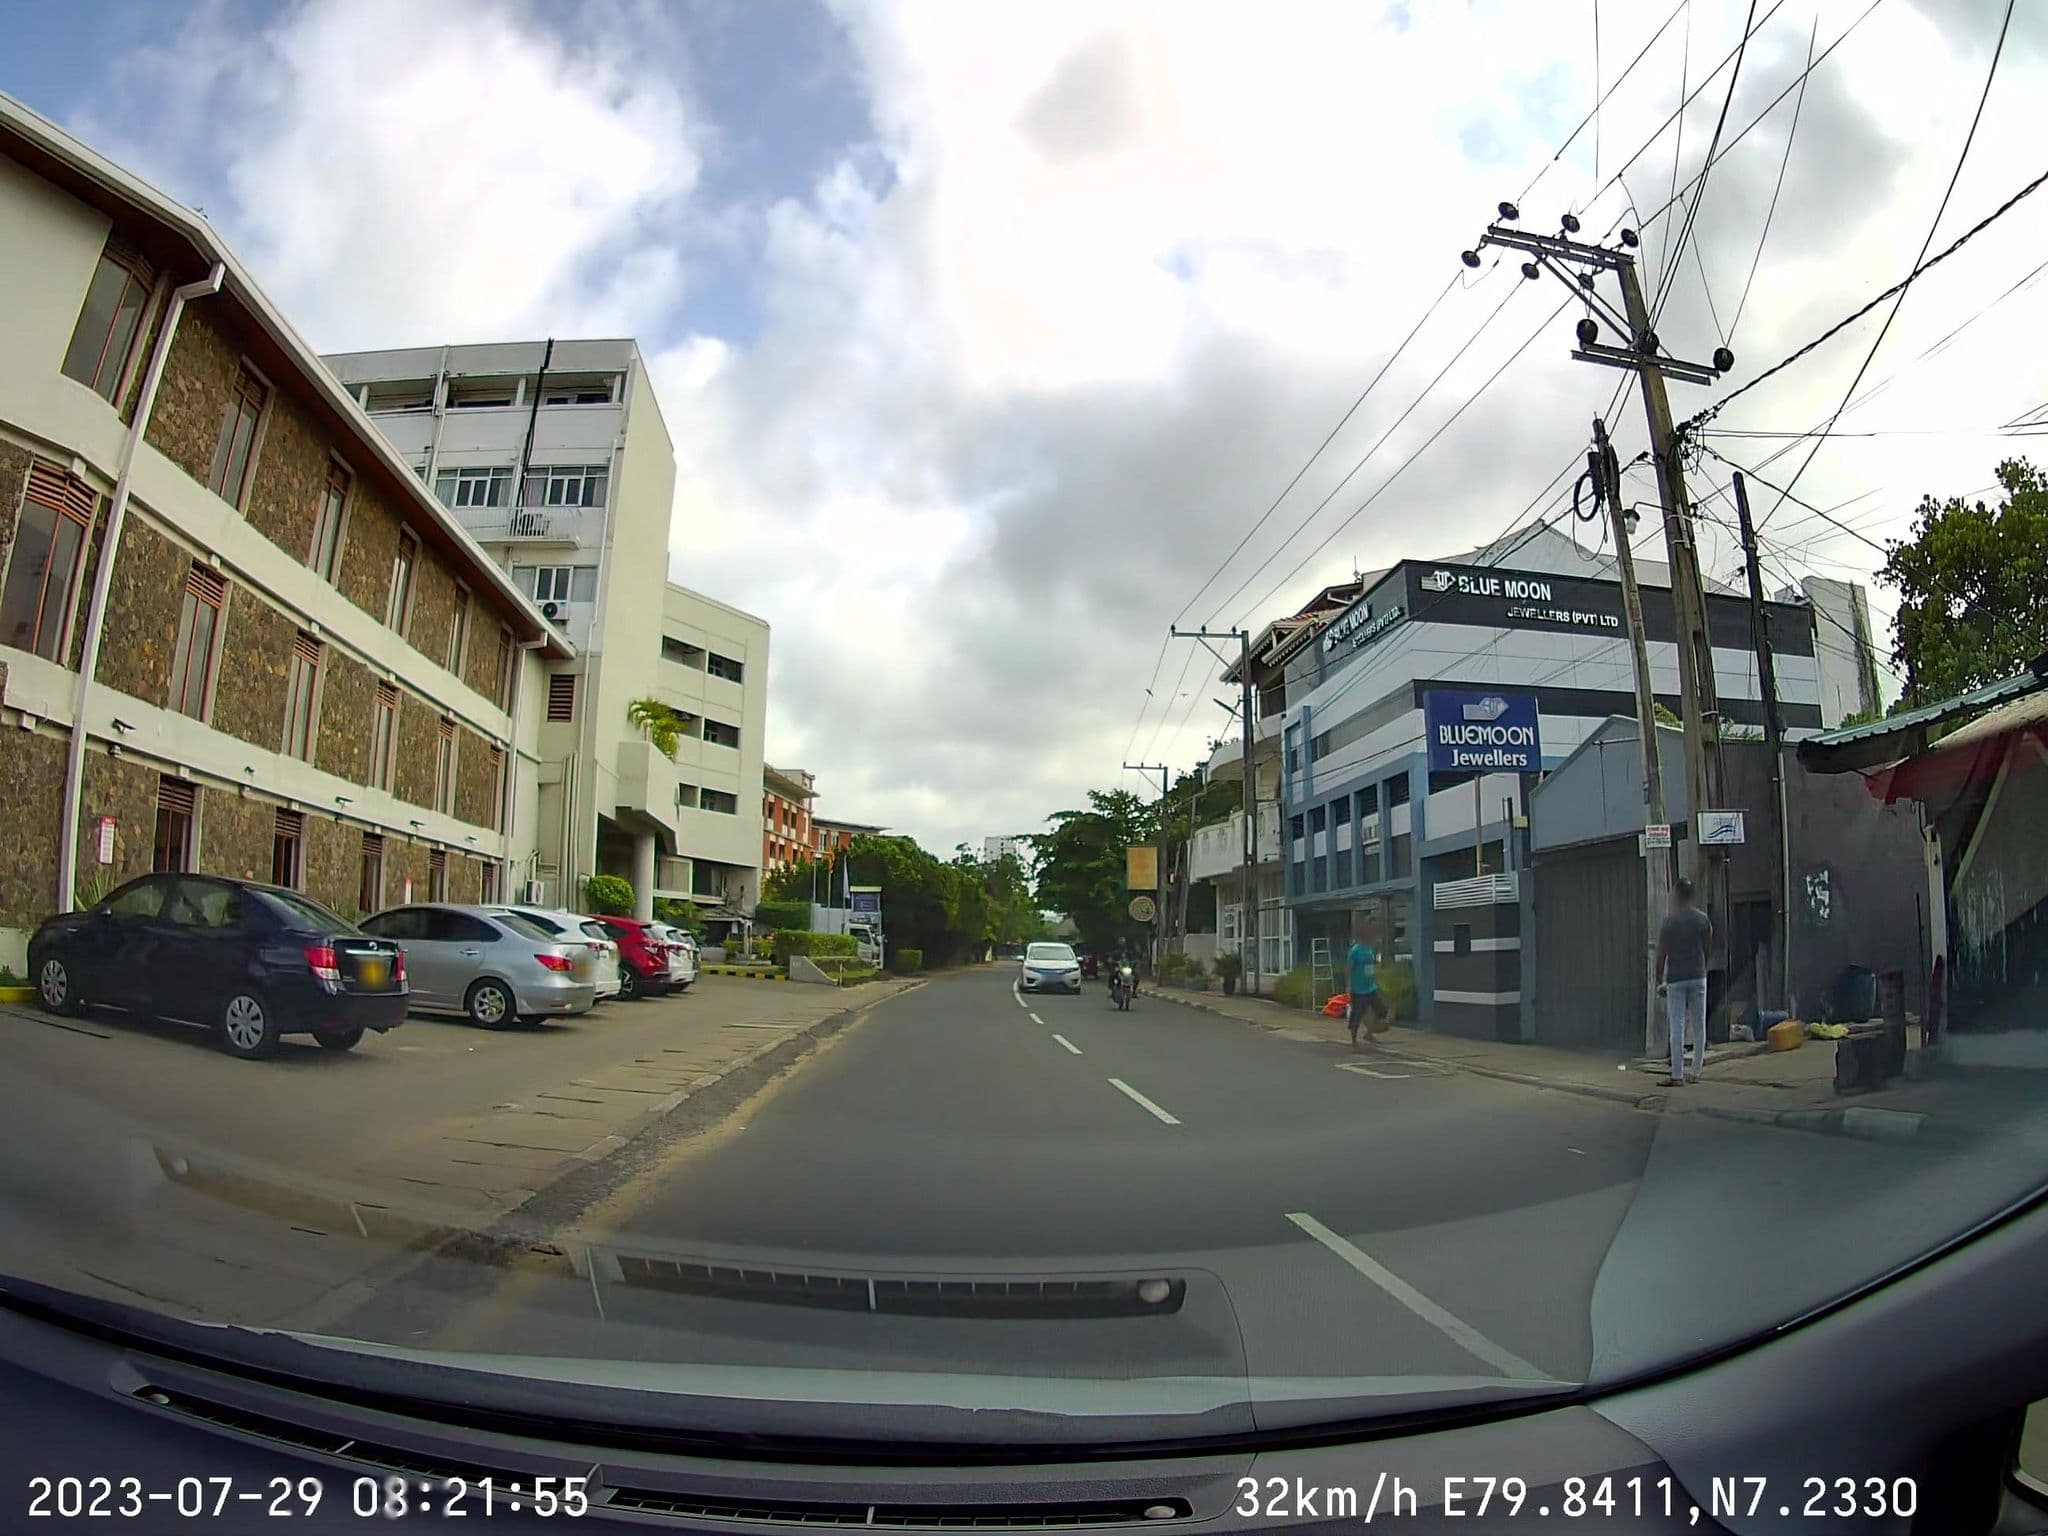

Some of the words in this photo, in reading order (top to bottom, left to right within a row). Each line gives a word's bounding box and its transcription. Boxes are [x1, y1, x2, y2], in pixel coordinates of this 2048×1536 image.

[1458, 575, 1502, 596] BLUE
[1504, 580, 1552, 601] MOON
[1507, 606, 1571, 623] JEWELLERS
[1571, 610, 1599, 626] (PVT)
[1599, 615, 1619, 627] LTD
[1439, 724, 1535, 746] BLUEMOON
[1451, 748, 1528, 767] Jewellers
